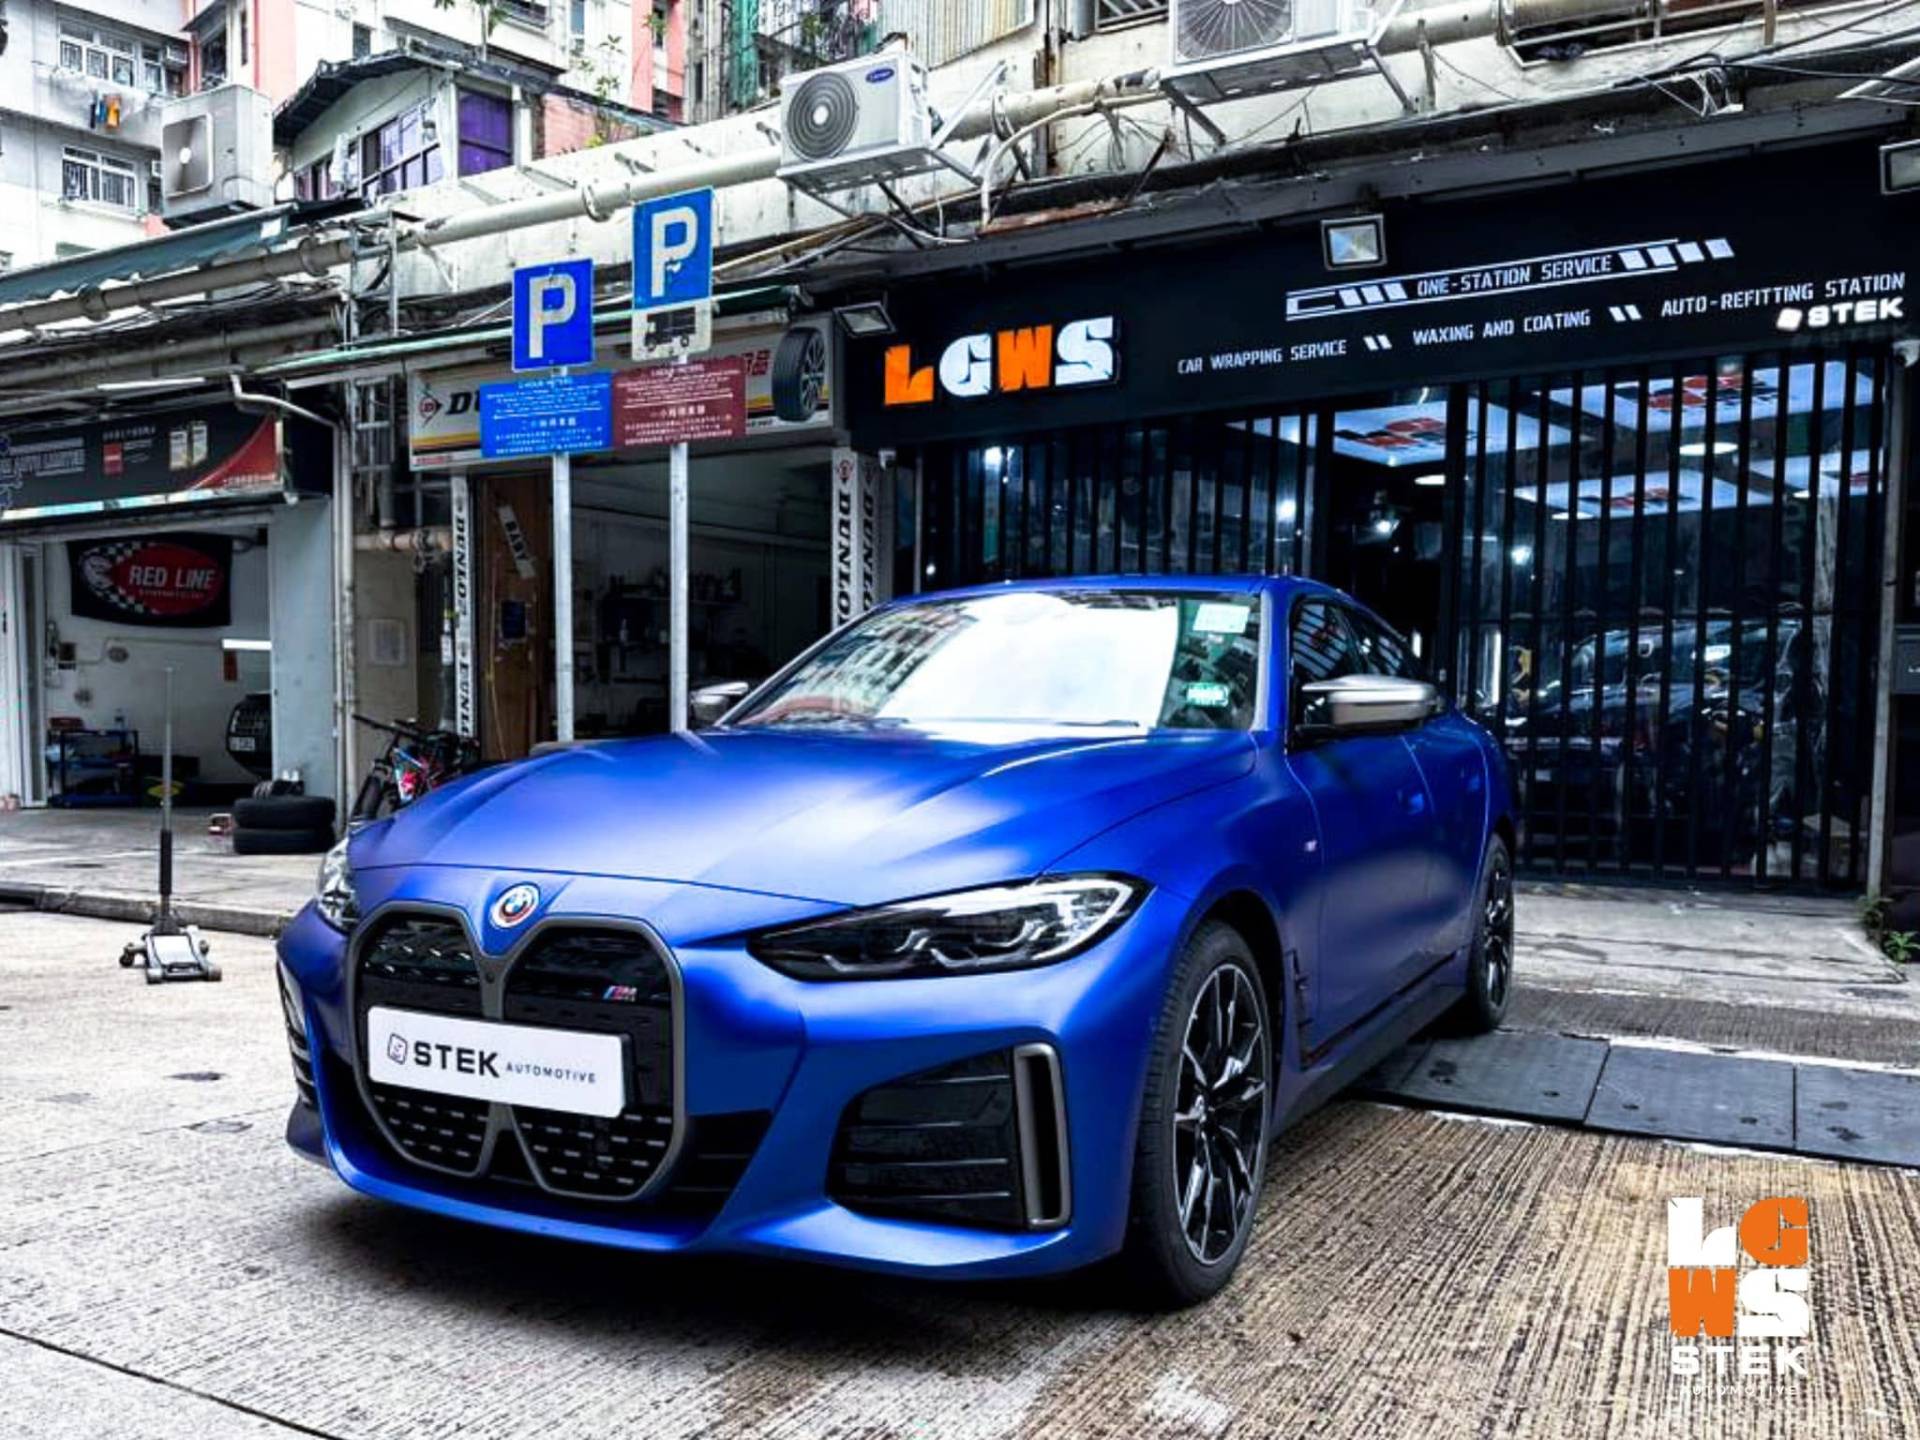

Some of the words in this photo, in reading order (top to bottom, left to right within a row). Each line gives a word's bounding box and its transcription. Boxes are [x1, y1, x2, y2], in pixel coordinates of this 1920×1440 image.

[651, 206, 699, 298] P
[1416, 265, 1531, 298] ONE-STATION
[1541, 255, 1613, 280] SERVICE
[1661, 284, 1814, 318] AUTO-REFITTING
[1825, 272, 1906, 298] STATION
[528, 273, 576, 359] P
[1412, 323, 1474, 347] WAXING
[1482, 318, 1515, 338] AND
[1524, 309, 1591, 333] COATING
[1808, 296, 1904, 328] STEK
[884, 316, 1115, 407] LGWS
[1177, 357, 1203, 375] CAR
[1211, 347, 1283, 372] WRAPPING
[1290, 339, 1347, 363] SERVICE
[129, 565, 168, 588] RED
[175, 567, 216, 591] LINE
[413, 1039, 500, 1079] STEK
[505, 1062, 597, 1084] AUTOMOTIVE
